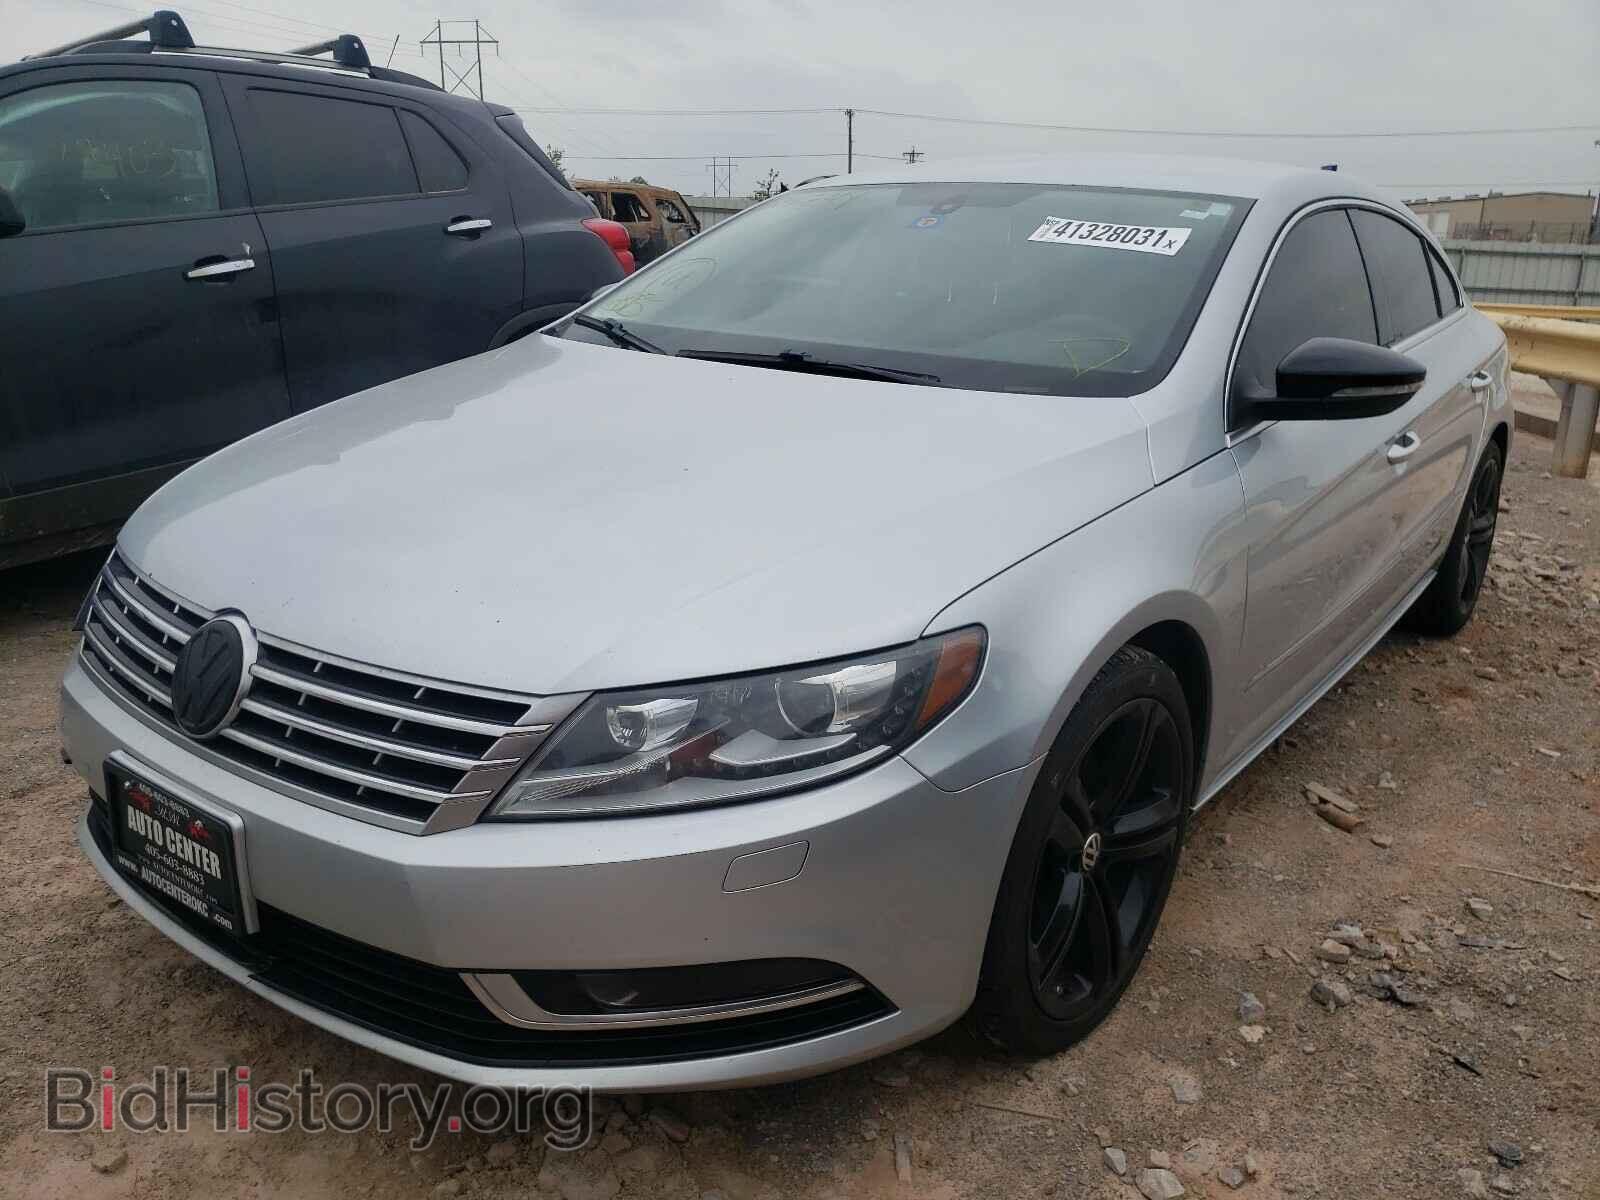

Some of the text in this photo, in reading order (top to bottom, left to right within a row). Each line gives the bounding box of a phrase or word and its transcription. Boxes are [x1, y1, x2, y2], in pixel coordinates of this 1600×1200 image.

[1053, 221, 1168, 247] 41328031
[127, 804, 222, 880] AUTO CENTER
